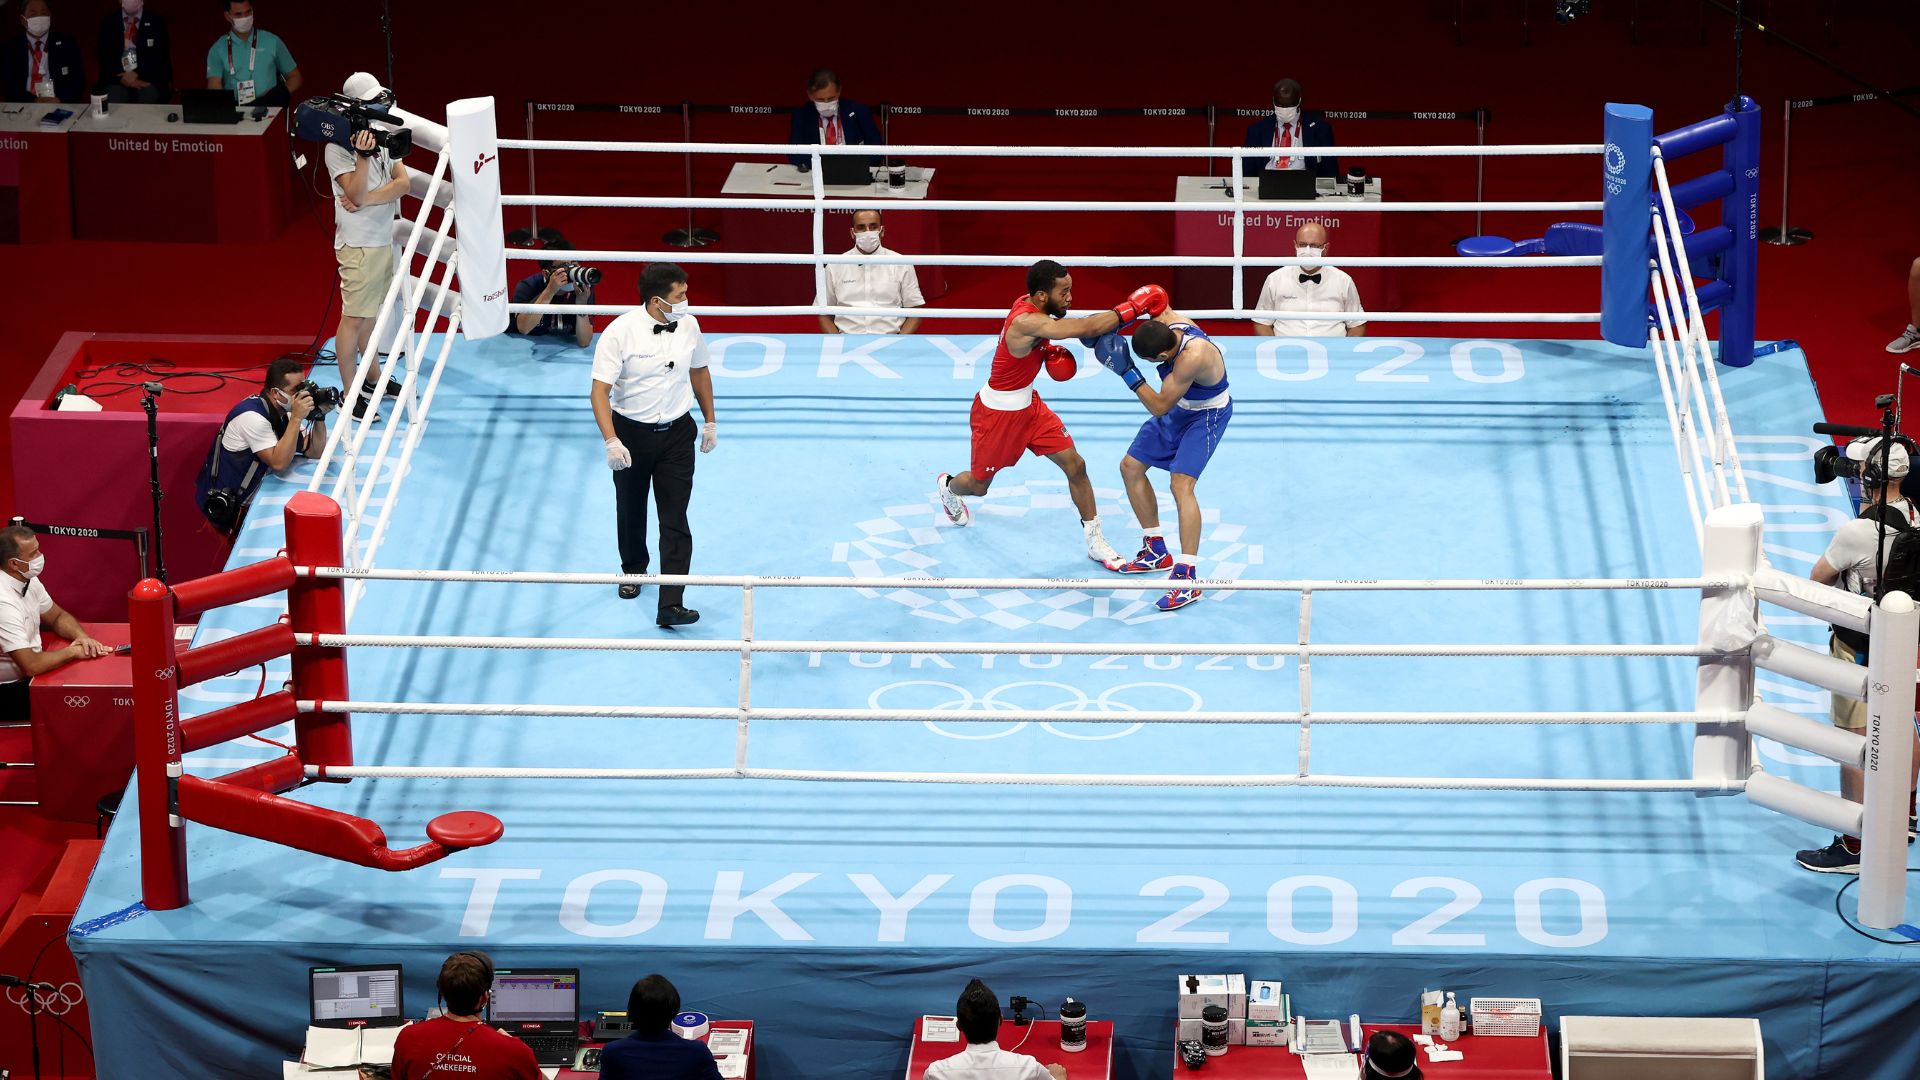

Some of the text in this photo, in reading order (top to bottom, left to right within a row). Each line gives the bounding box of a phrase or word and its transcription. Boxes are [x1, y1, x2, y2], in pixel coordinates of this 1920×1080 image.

[619, 105, 661, 114] TOKYO 2020
[730, 106, 772, 114] TOKYO 2020
[904, 106, 921, 114] 2020
[967, 108, 1010, 116] TOKYO 2020
[1143, 108, 1186, 116] TOKYO 2020
[1260, 109, 1276, 117] 202
[1325, 111, 1367, 119] TOKYO 2020
[1413, 111, 1456, 120] TOKYO 2020
[109, 138, 223, 153] United by Emotion
[1218, 214, 1261, 227] Uned
[1266, 214, 1281, 229] by
[1212, 338, 1526, 384] 020
[48, 525, 98, 537] TOKYO 2020
[1626, 580, 1669, 588] TOKYO 2020
[165, 697, 176, 755] TOKYO 2020
[1870, 714, 1881, 771] TOKYO 2020
[438, 867, 1609, 947] TOKYO 2020
[436, 1052, 473, 1063] OFICIAL
[430, 1062, 477, 1073] TMEKEEPER
